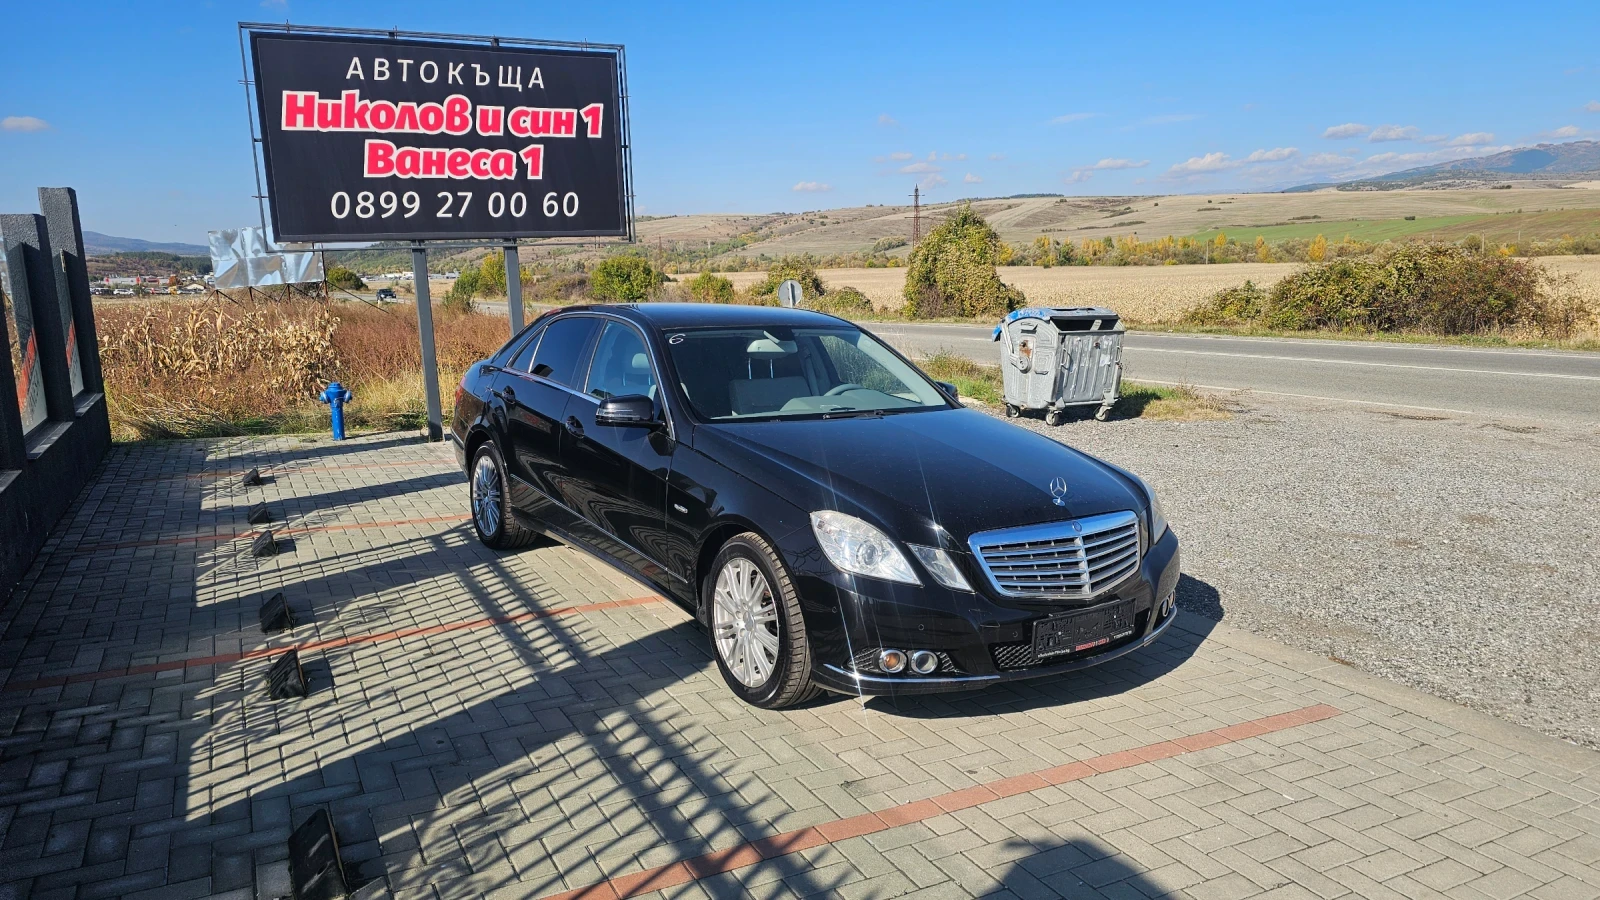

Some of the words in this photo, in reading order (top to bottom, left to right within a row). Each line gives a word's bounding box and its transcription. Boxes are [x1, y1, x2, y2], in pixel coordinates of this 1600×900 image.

[345, 56, 545, 93] АВТОКЪЩА
[281, 89, 472, 135] Николов
[476, 104, 505, 137] и
[507, 105, 577, 138] син
[579, 103, 604, 138] 1
[363, 139, 518, 180] Ванеса
[518, 143, 545, 180] 1
[330, 190, 421, 219] 0899
[436, 191, 473, 218] 27
[487, 191, 527, 218] 00
[542, 191, 579, 217] 60
[668, 333, 686, 345] 6
